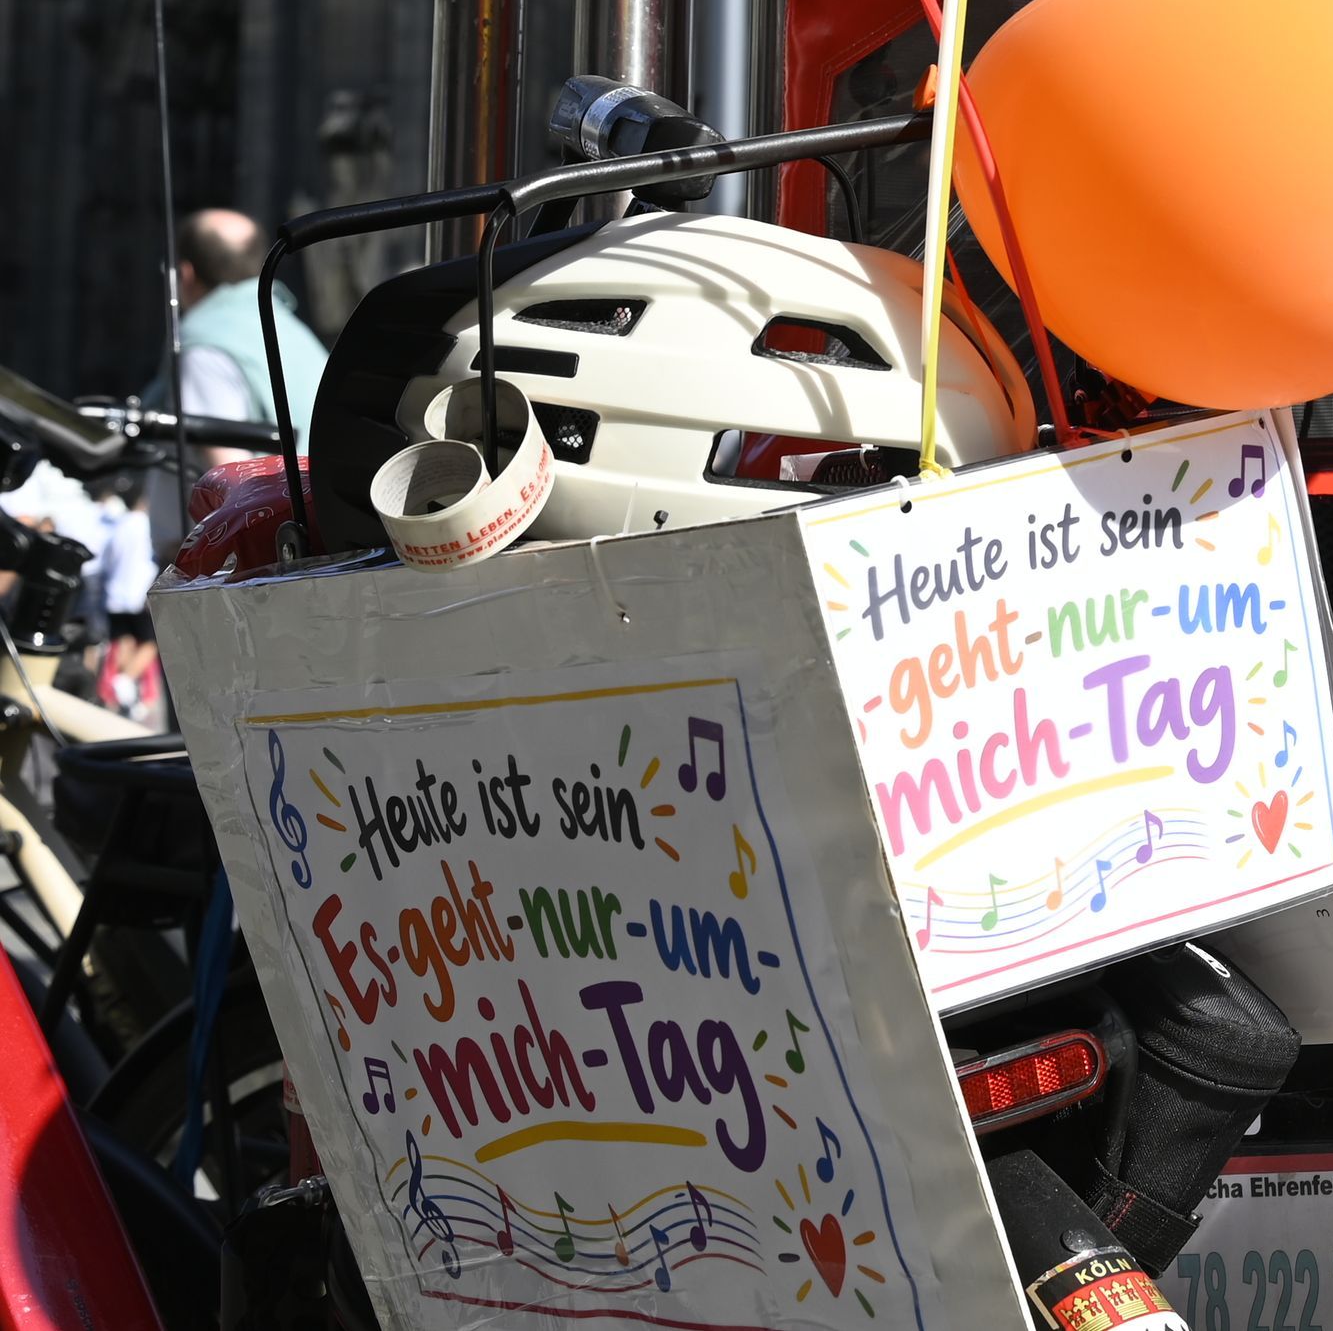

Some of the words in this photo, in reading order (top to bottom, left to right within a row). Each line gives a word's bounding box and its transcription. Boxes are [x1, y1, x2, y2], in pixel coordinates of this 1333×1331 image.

[862, 526, 1009, 641] Heute
[1026, 503, 1080, 571] ist
[1099, 494, 1185, 558] sein
[856, 579, 1286, 749] -geht-nur-um-
[348, 759, 469, 881] Heute
[471, 754, 544, 840] ist
[550, 764, 646, 851] sein
[874, 652, 1236, 857] mich-Tag
[311, 859, 781, 1026] Es-geht-nur-um-
[1317, 908, 1330, 918] 3
[412, 979, 768, 1174] mich-Tag
[1074, 1258, 1132, 1285] KÖLN
[1242, 1249, 1323, 1331] 222
